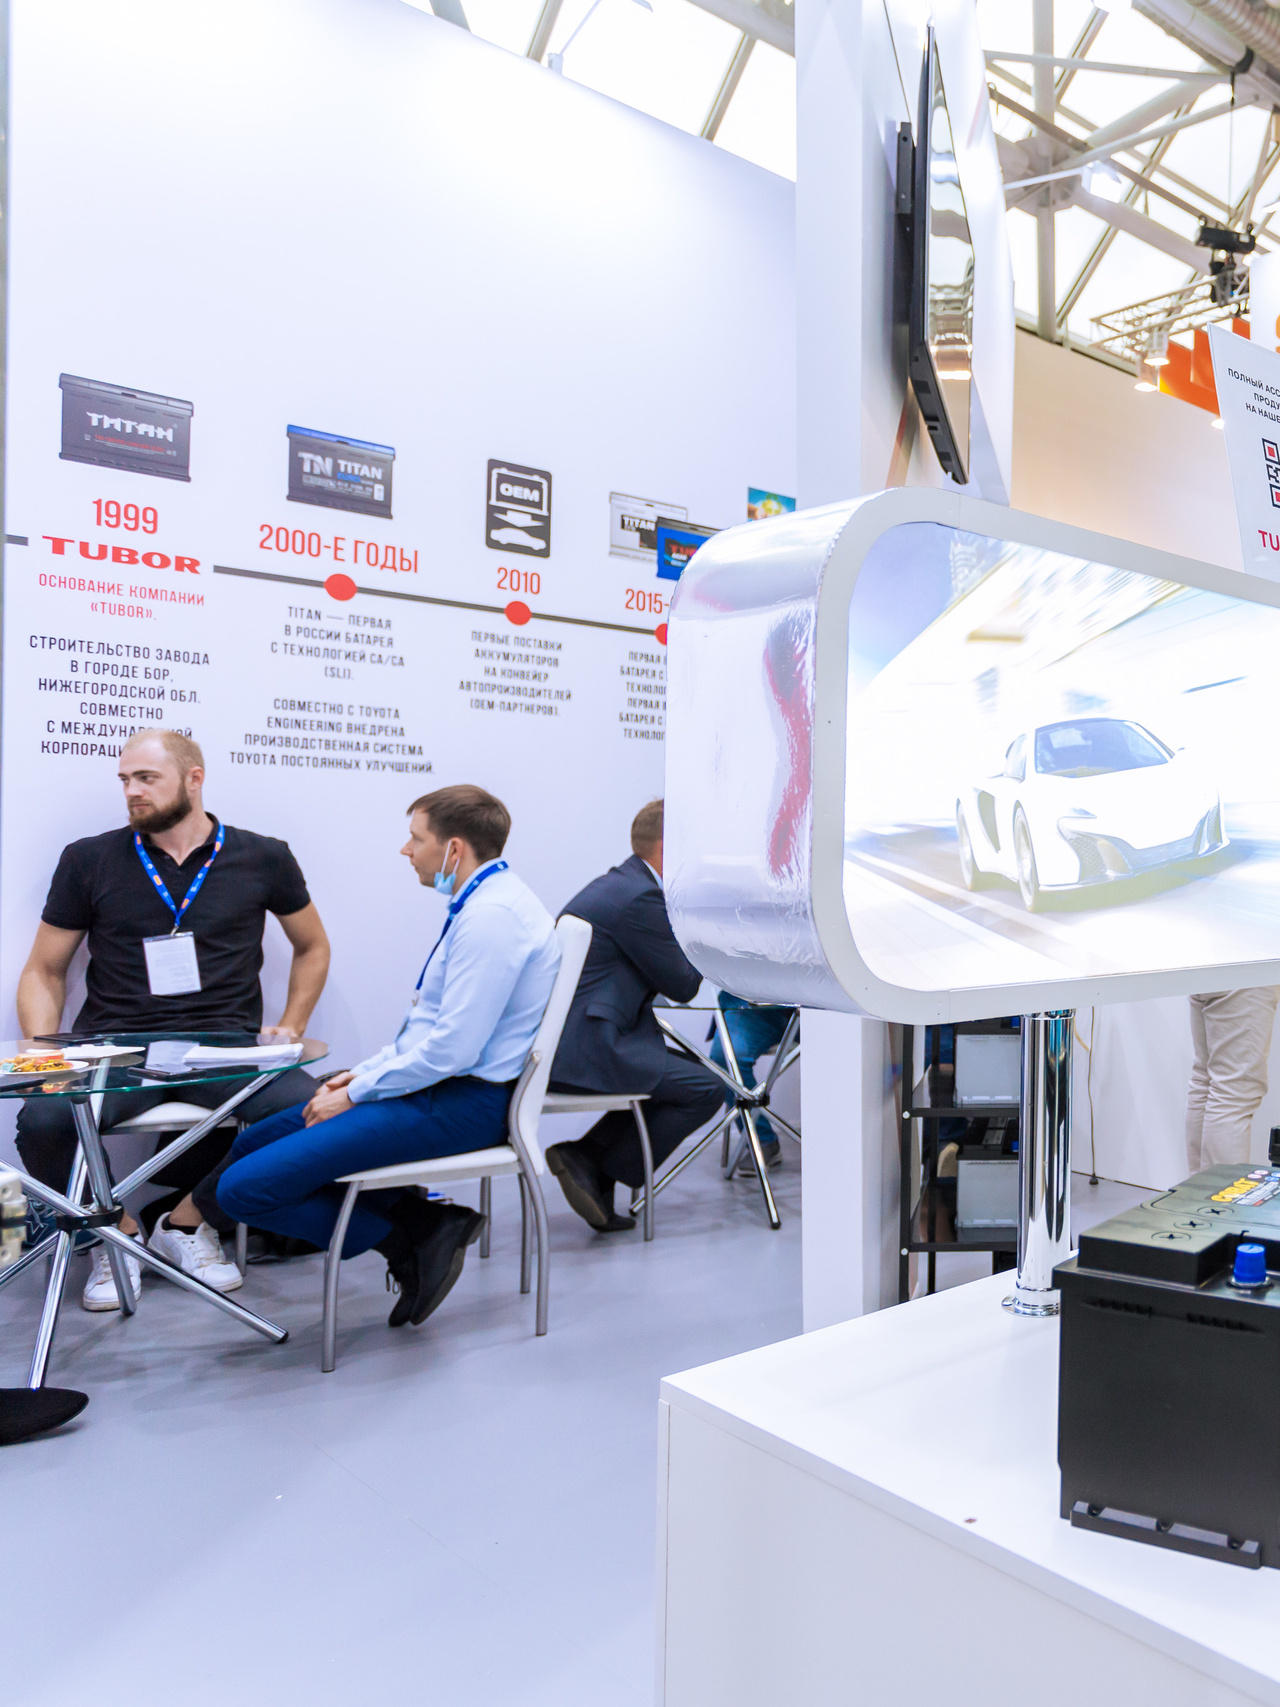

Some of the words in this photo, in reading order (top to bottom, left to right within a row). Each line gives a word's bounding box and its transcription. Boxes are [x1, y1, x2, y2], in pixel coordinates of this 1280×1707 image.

[1227, 367, 1264, 391] ПОЛНЫЙ
[1245, 402, 1257, 415] НА
[86, 411, 174, 443] ТИТАН
[337, 459, 383, 480] TITAN
[499, 482, 540, 503] OEM
[92, 498, 159, 535] 1999
[622, 516, 656, 531] TITAN
[41, 535, 202, 575] TUBOR
[259, 523, 346, 562] 2000-Е
[353, 539, 418, 573] ГОДЫ
[38, 573, 124, 597] ОСНОВАНИЕ
[129, 585, 205, 607] КОМПАНИИ
[496, 566, 541, 595] 2010
[287, 605, 322, 621] TITAN
[348, 614, 392, 630] ПЕРВАЯ
[284, 625, 292, 636] В
[296, 626, 341, 642] РОССИИ
[345, 632, 394, 648] БАТАРЕЯ
[471, 630, 510, 646] ПЕРВЫЕ
[513, 636, 562, 652] ПОСТАВКИ
[29, 635, 151, 660] СТРОИТЕЛЬСТВО
[155, 648, 210, 665] ЗАВОДА
[270, 642, 278, 653] С
[283, 643, 366, 663] ТЕХНОЛОГИЕЙ
[474, 648, 559, 668] АККУМУЛЯТОРОВ
[628, 651, 661, 664] ПЕРВАЯ
[70, 660, 79, 673] В
[84, 661, 139, 679] ГОРОДЕ
[144, 667, 174, 683] БОР,
[484, 666, 497, 677] НА
[500, 668, 549, 683] КОНВЕЙЕР
[619, 665, 656, 679] БАТАРЕЯ
[38, 677, 166, 701] НИЖЕГОРОДСКОЙ
[170, 689, 202, 704] ОБЛ.
[459, 680, 572, 702] АВТОПРОИЗВОДИТЕЛЕЙ
[80, 702, 164, 720] СОВМЕСТНО
[273, 698, 344, 716] СОВМЕСТНО
[347, 704, 354, 716] С
[359, 705, 400, 719] TOYOTA
[627, 697, 660, 711] ПЕРВАЯ
[46, 720, 55, 733] С
[61, 721, 193, 740] МЕЖДУНАОЙ
[267, 716, 342, 733] ENGINEERING
[346, 722, 405, 738] ВНЕДРЕНА
[619, 712, 655, 726] БАТАРЕЯ
[244, 733, 370, 754] ПРОИЗВОДСТВЕННАЯ
[373, 742, 424, 757] СИСТЕМА
[230, 751, 277, 766] TOYOTA
[281, 754, 361, 771] ПОСТОЯННЫХ
